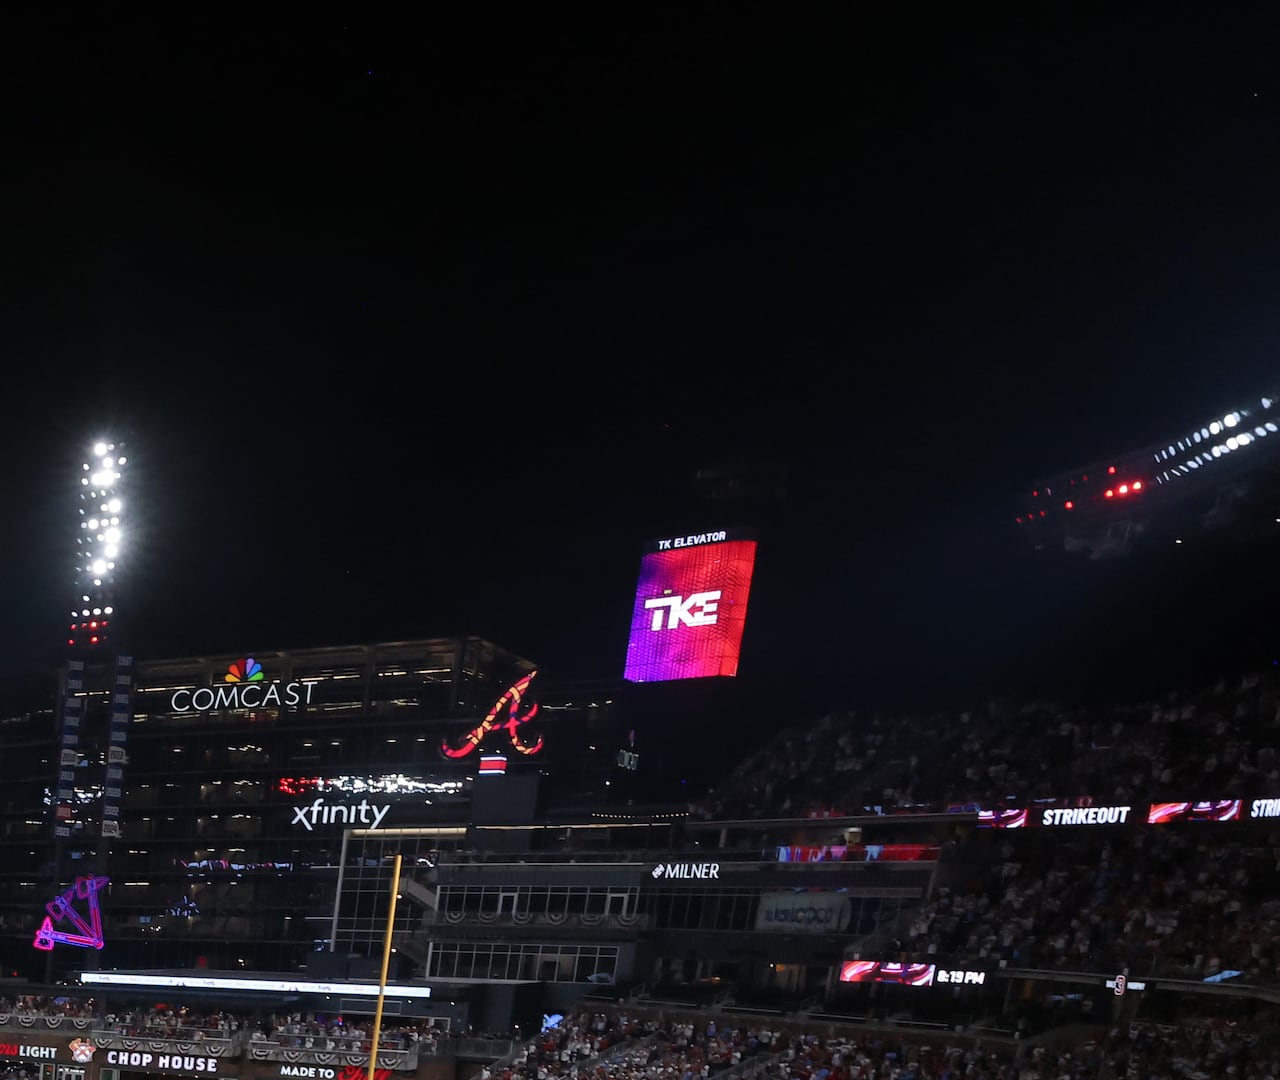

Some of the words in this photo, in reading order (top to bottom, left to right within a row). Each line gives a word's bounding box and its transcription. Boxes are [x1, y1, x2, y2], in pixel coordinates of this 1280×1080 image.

[658, 540, 672, 550] TK
[673, 531, 727, 548] ELEVATOR
[644, 590, 722, 631] TKE
[171, 681, 318, 712] COMCAST
[290, 798, 391, 831] xfinity
[1042, 806, 1131, 826] STRIKEOUT
[665, 863, 720, 879] MILNER
[964, 972, 986, 985] PM
[19, 1045, 57, 1059] LIGHT
[107, 1049, 154, 1068] CHOP
[158, 1054, 218, 1073] HOUSE
[280, 1065, 315, 1078] MADE
[316, 1066, 335, 1079] TO
